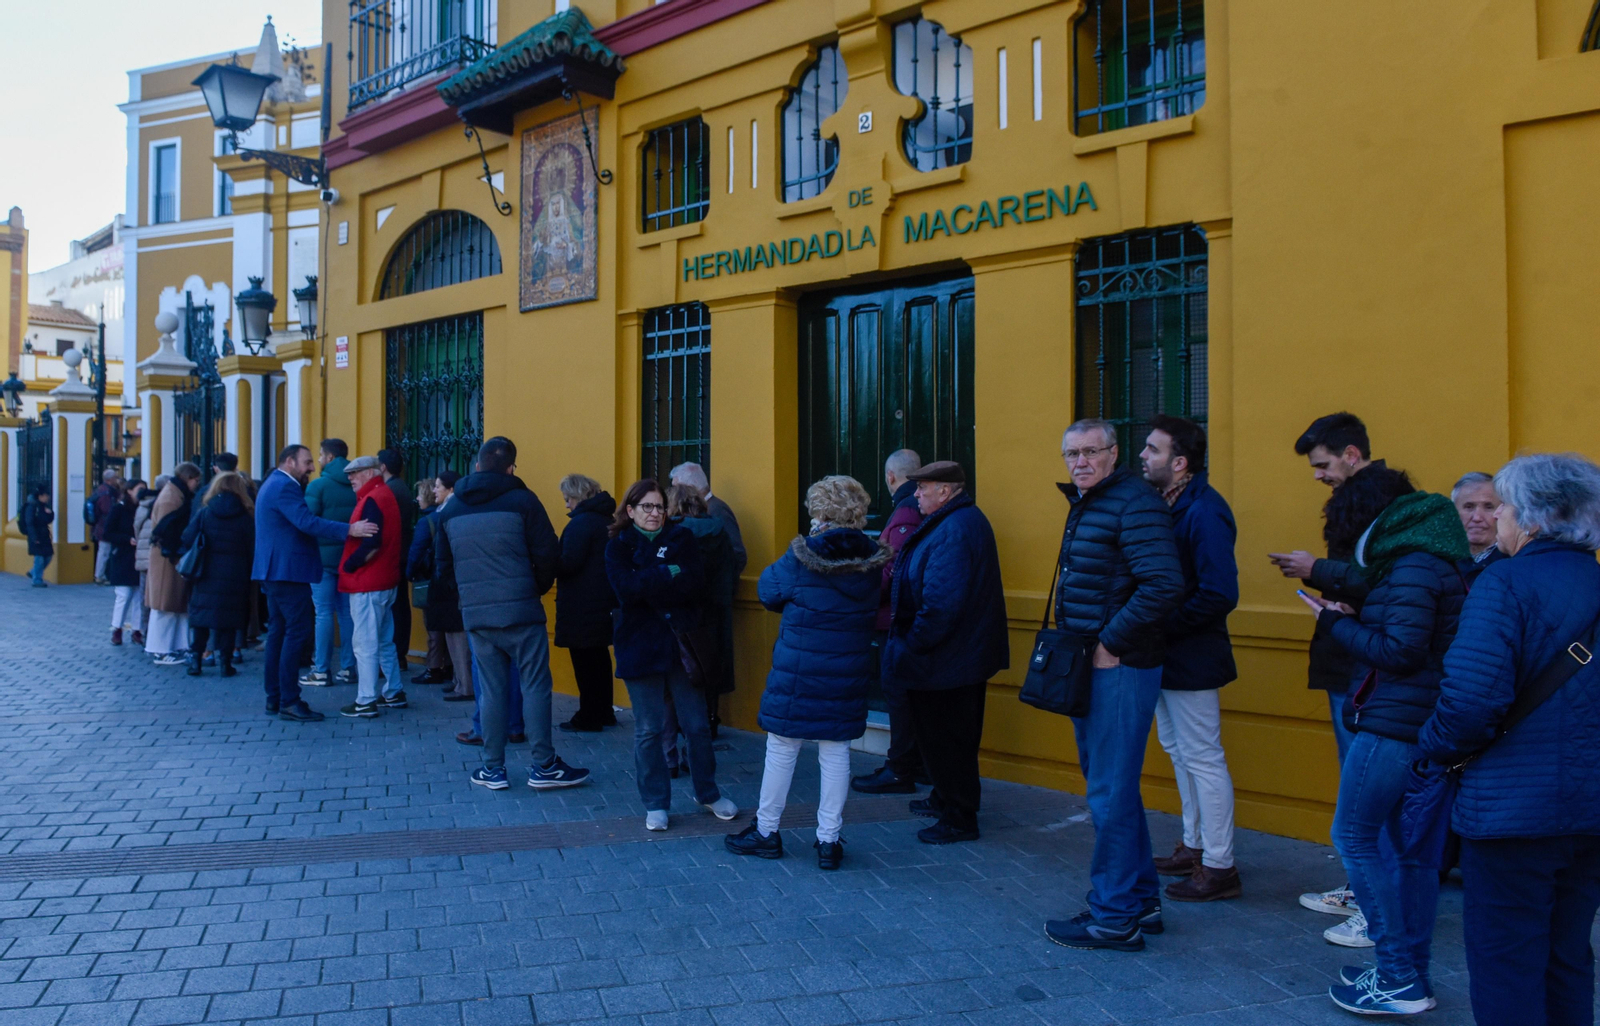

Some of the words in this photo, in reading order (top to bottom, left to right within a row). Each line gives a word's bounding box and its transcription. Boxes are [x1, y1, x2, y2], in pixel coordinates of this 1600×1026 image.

[860, 114, 871, 131] 2
[848, 186, 873, 209] DE
[682, 230, 843, 282] HERMANDAD
[846, 225, 876, 251] LA
[903, 181, 1098, 244] MACARENA
